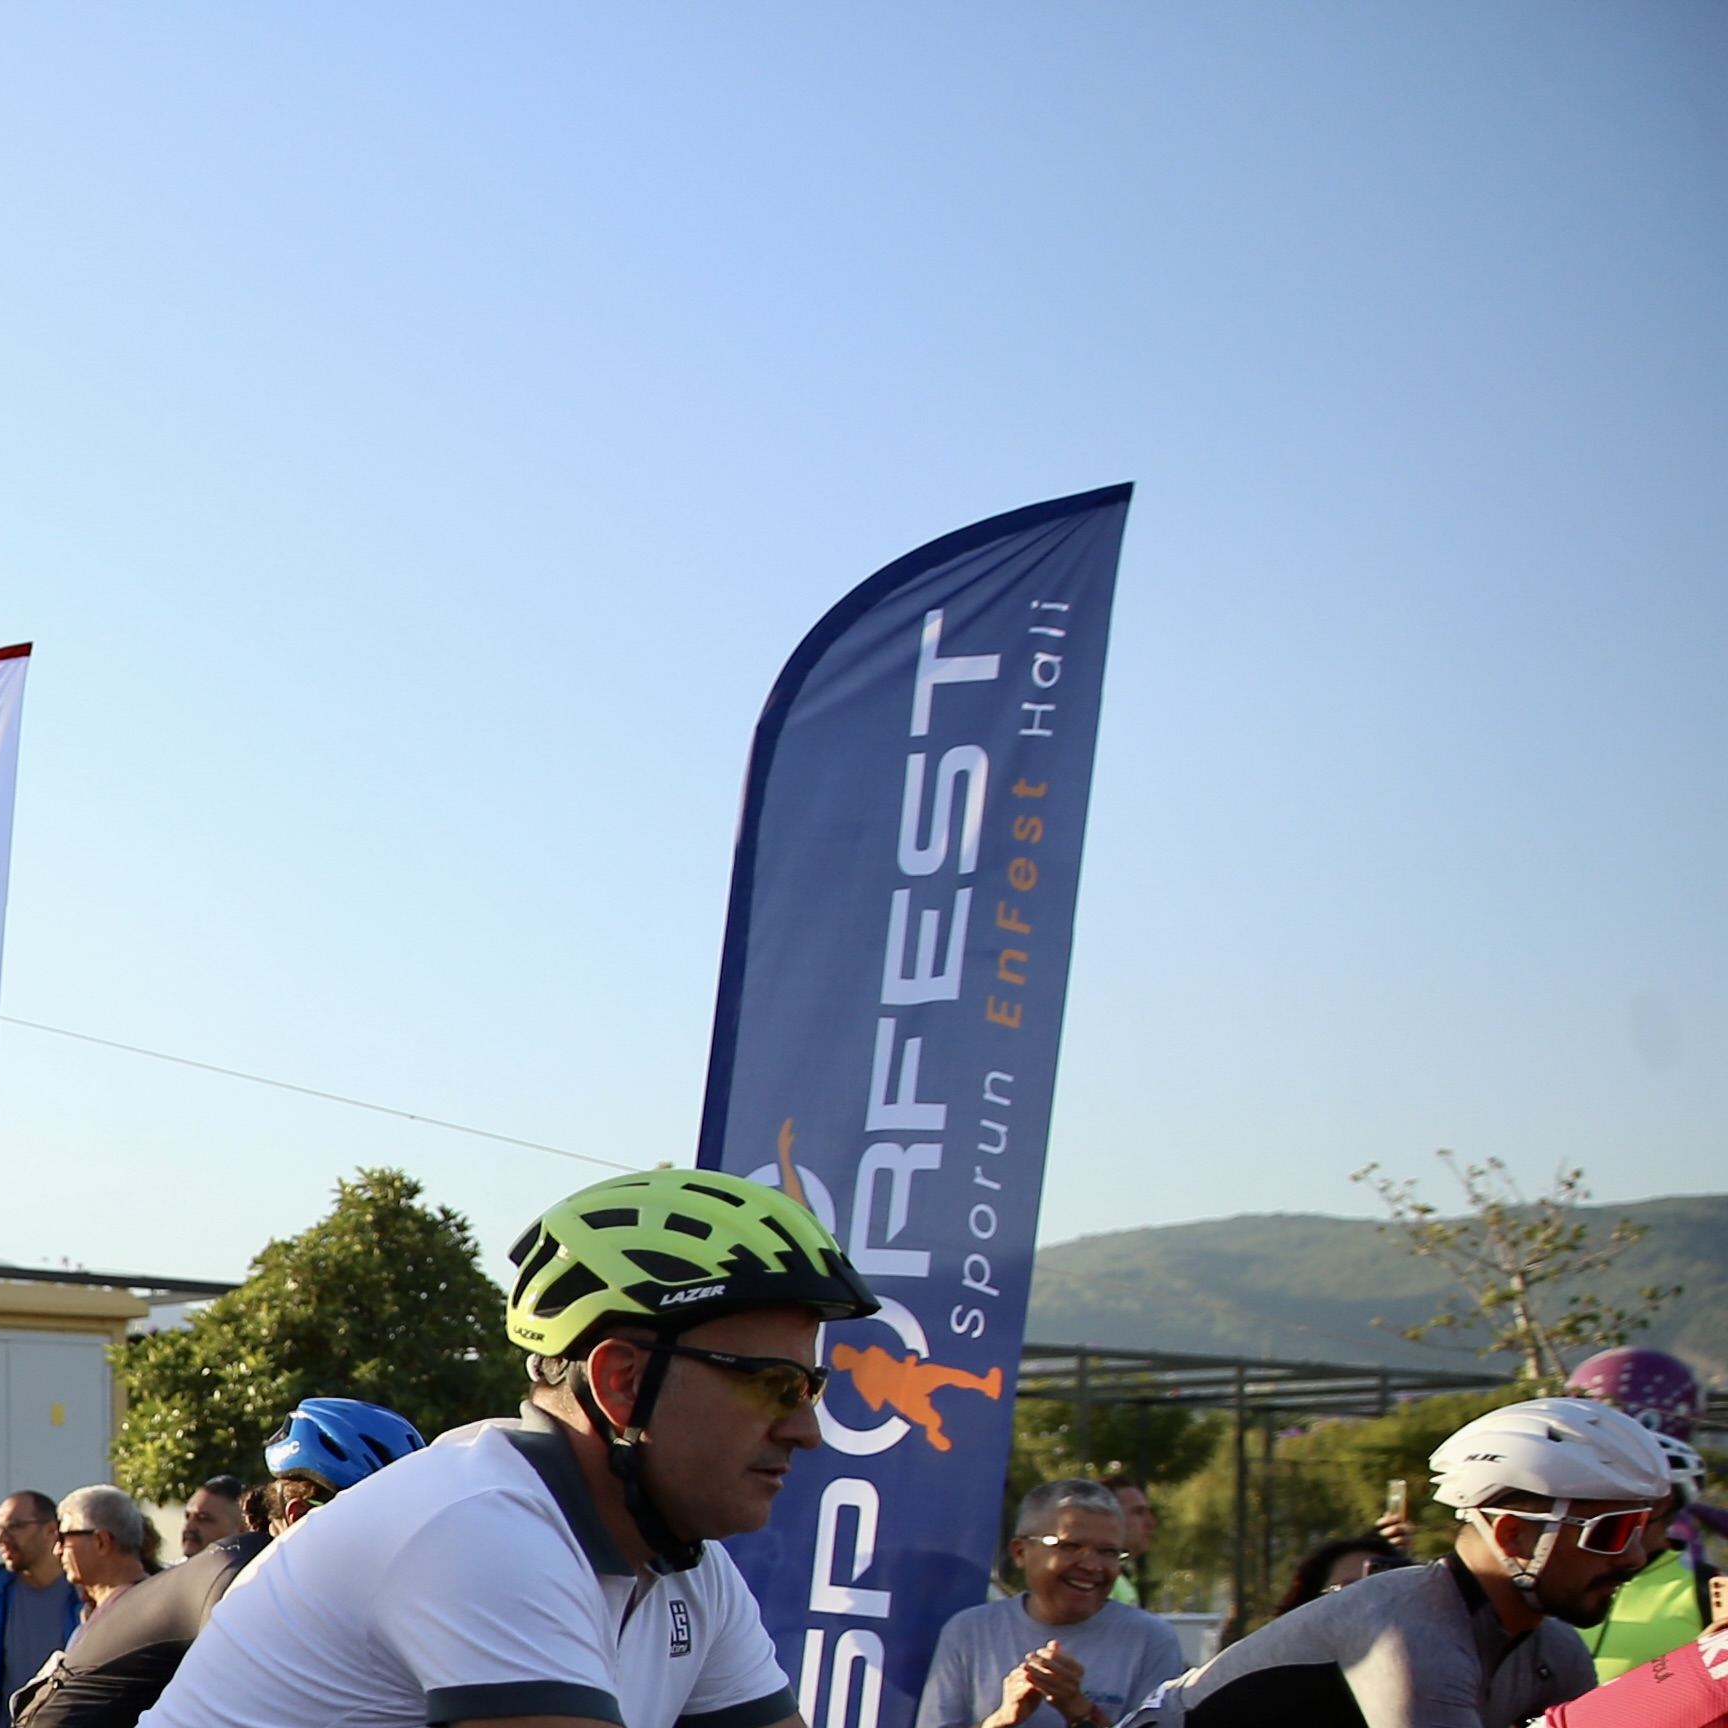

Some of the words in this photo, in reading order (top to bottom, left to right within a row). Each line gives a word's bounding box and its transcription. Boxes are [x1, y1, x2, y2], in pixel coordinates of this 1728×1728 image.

[949, 1068, 1016, 1340] Sporun
[986, 778, 1048, 1029] EnFest
[1018, 599, 1070, 738] Hali
[659, 1285, 726, 1306] LAZER
